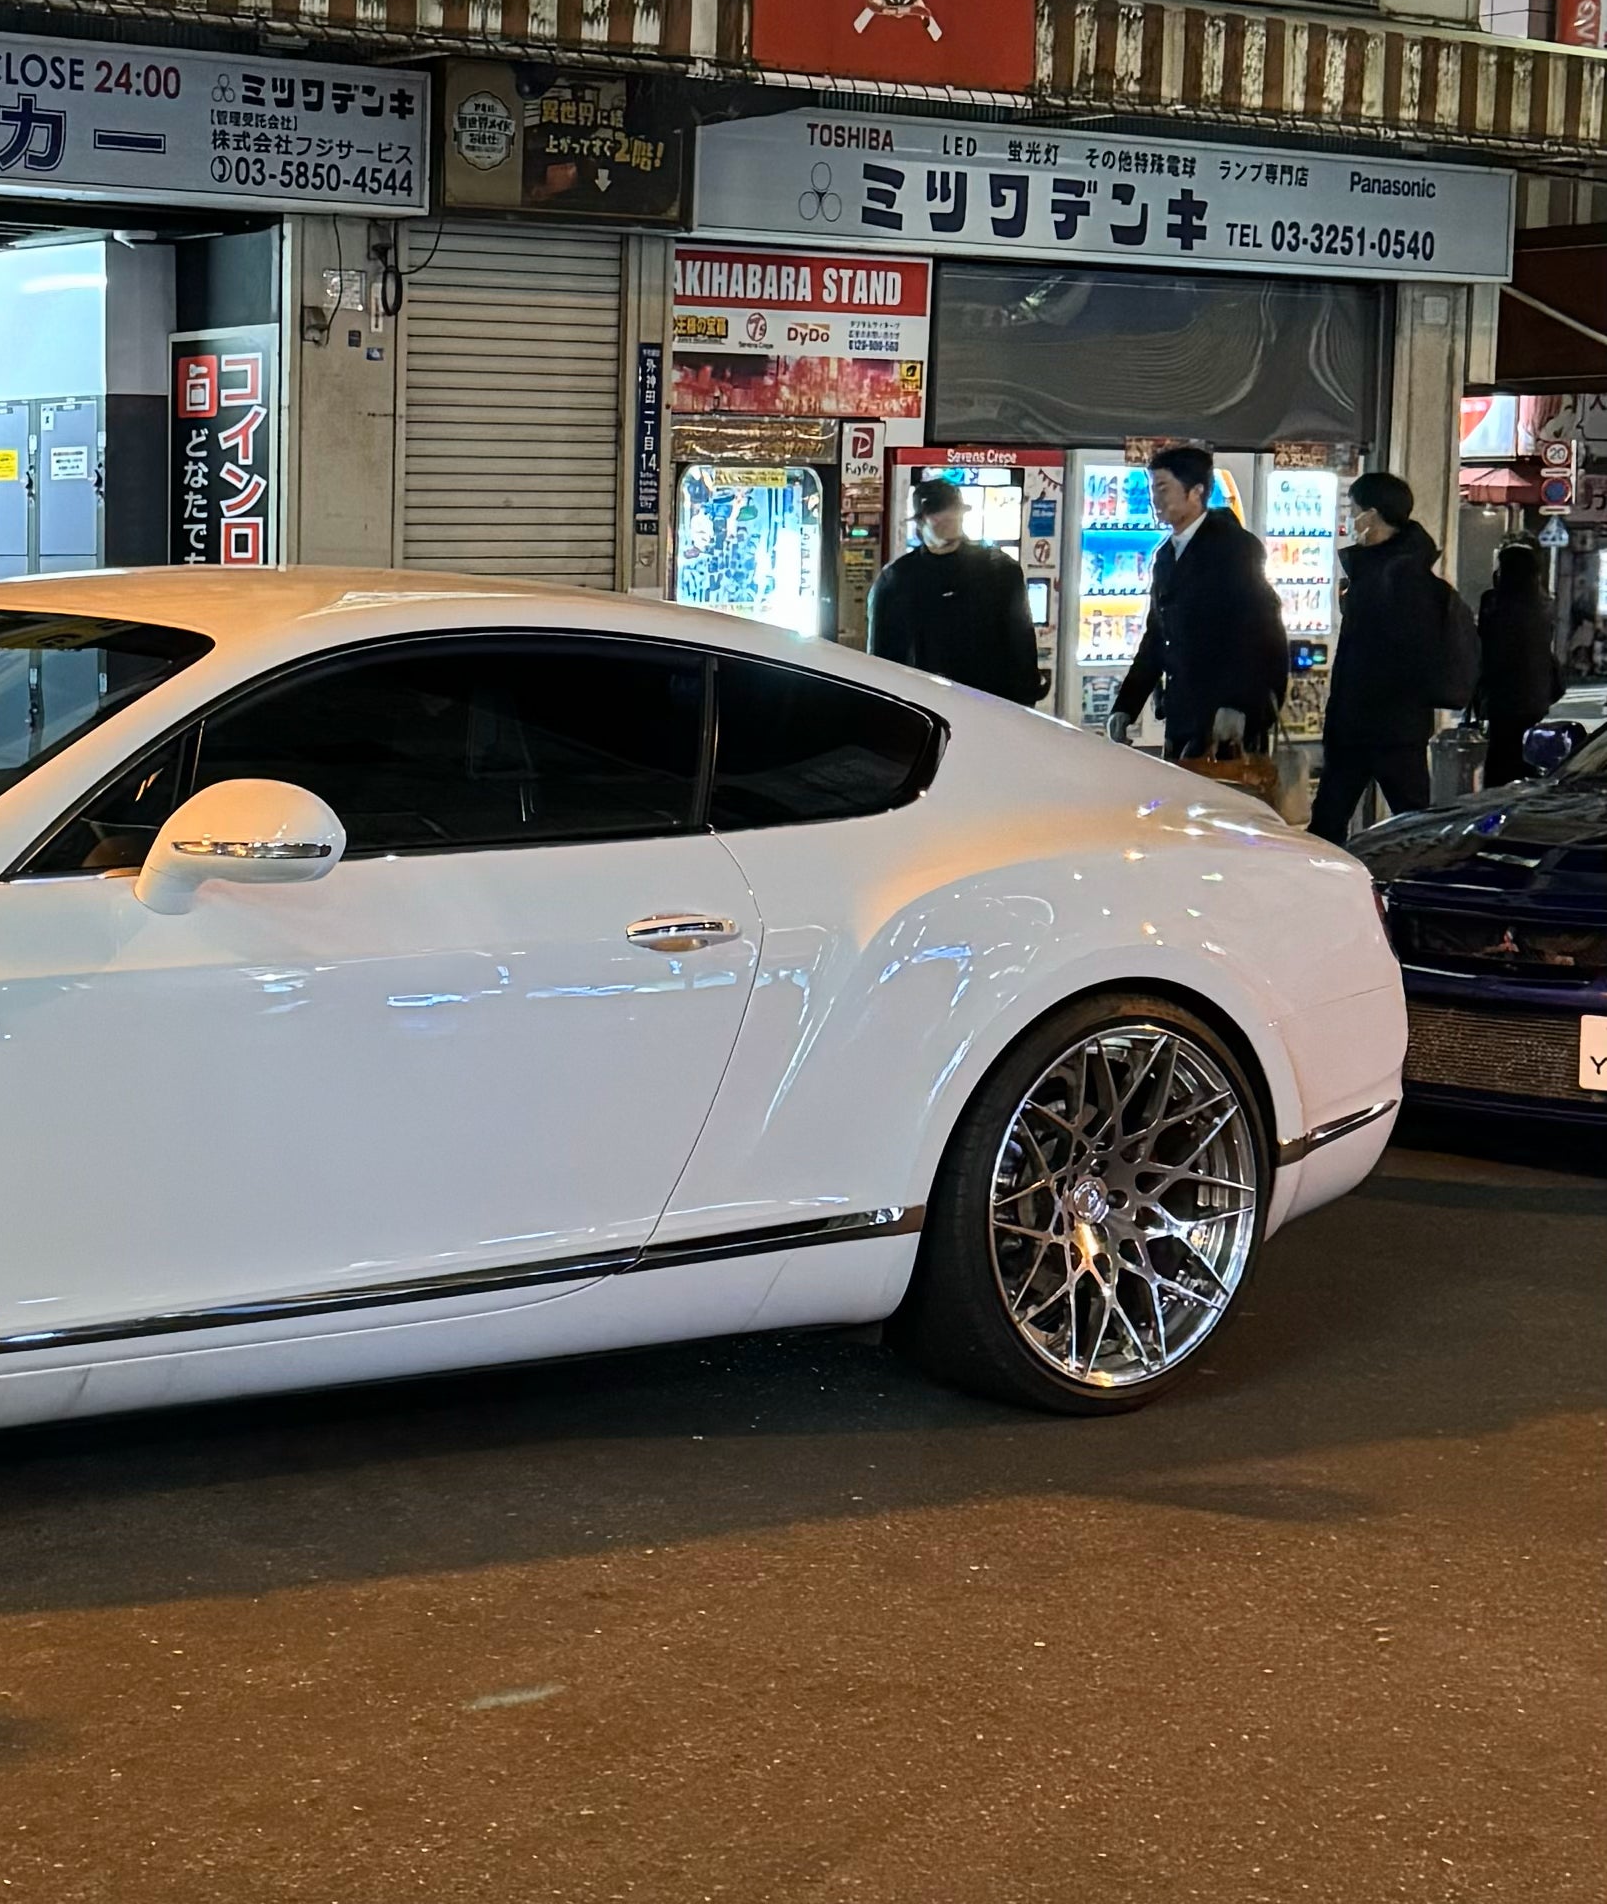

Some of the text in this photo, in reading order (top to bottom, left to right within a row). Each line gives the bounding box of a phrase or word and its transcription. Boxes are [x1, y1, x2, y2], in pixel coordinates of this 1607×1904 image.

[94, 59, 182, 100] 24:00
[242, 73, 415, 120] ミツワデンキ
[210, 129, 413, 165] 株式会社フジサービス
[806, 122, 895, 153] TOSHIBA
[235, 156, 414, 197] 03-5850-4544
[943, 135, 1310, 188] LED 蛍光灯 その他特殊電球 ランプ専門店
[1350, 171, 1437, 199] Panasonic
[861, 162, 1209, 251] ミツワデンキ
[1226, 219, 1435, 262] TEL 03-3251-0540
[674, 258, 903, 307] AKIHABARA STAND
[787, 327, 830, 346] DyDo
[644, 357, 657, 451] 外神田一丁目
[1549, 447, 1566, 461] 20
